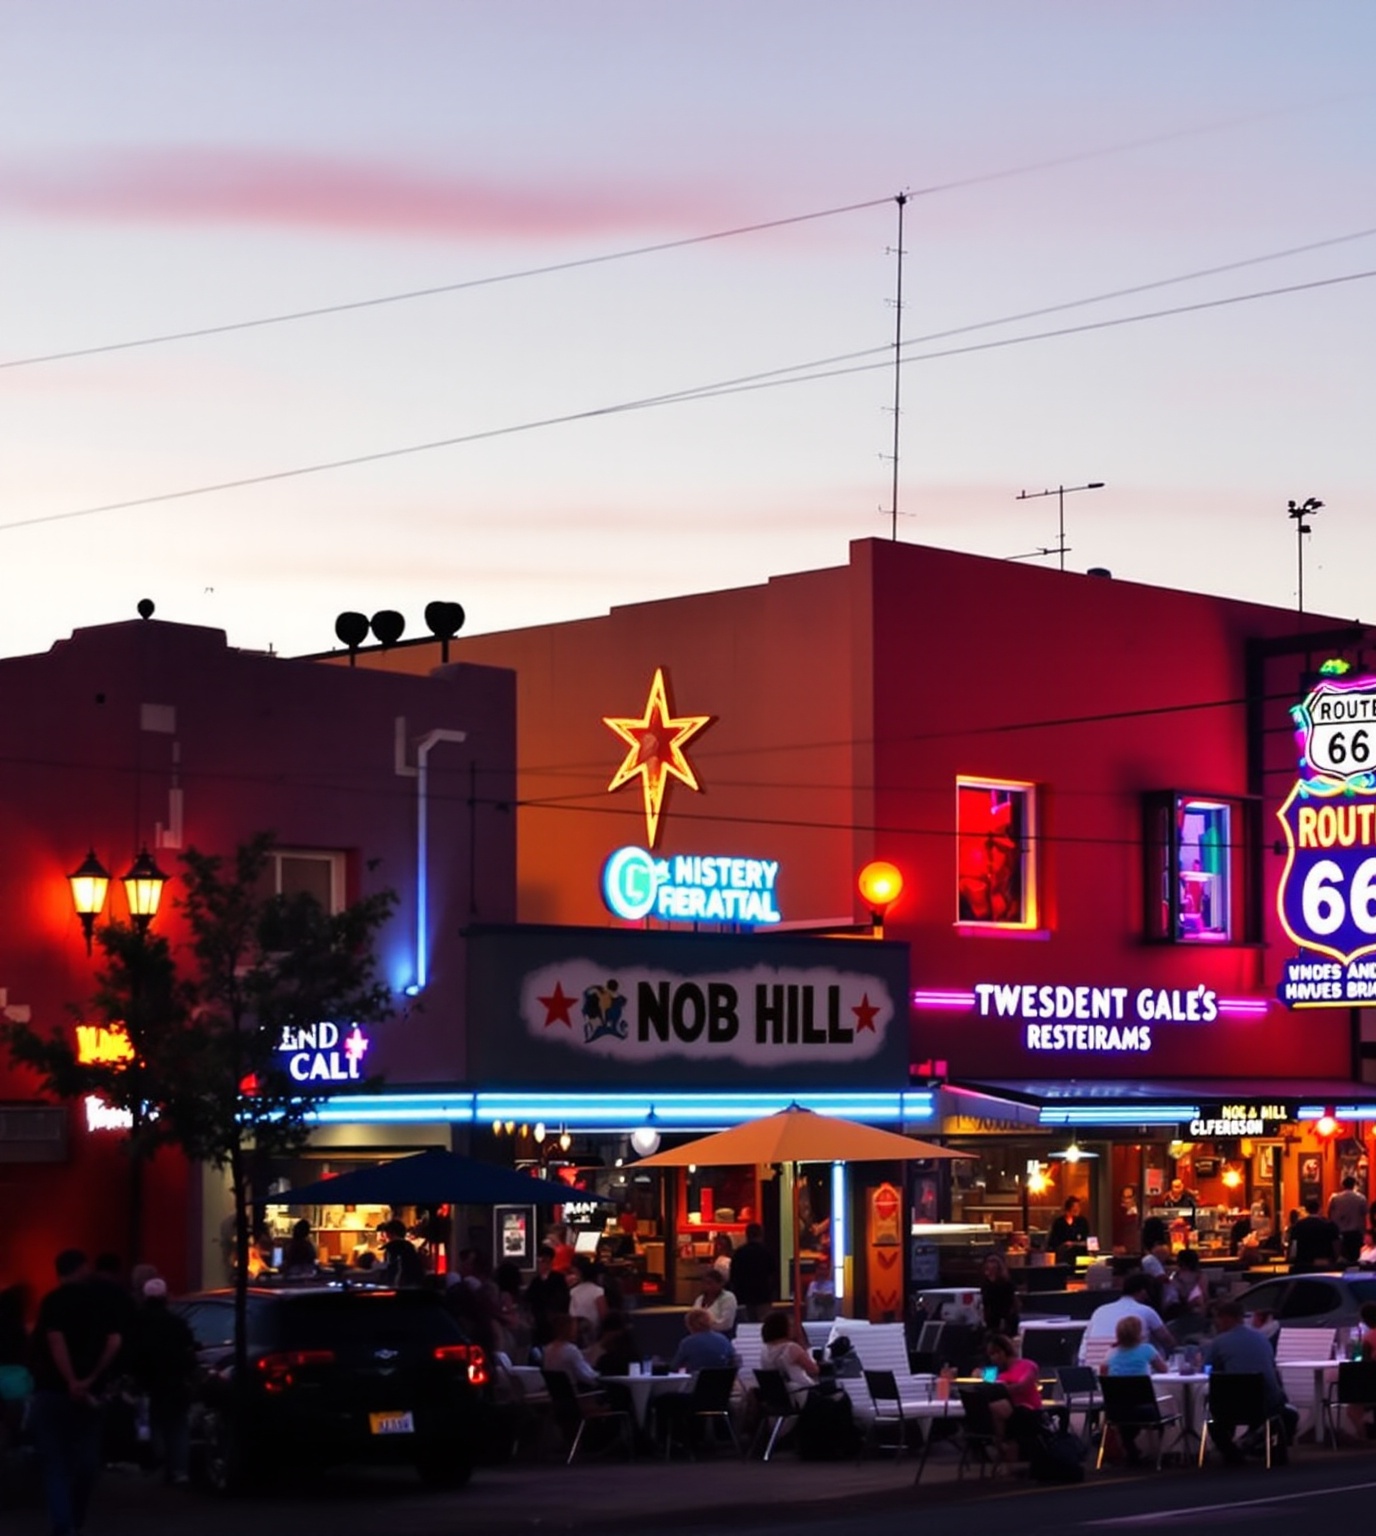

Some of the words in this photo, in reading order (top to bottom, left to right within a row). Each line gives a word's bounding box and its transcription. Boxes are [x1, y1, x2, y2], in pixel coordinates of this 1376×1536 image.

[1328, 729, 1370, 764] 66
[637, 981, 740, 1043] NOB
[755, 984, 854, 1044] HILL
[975, 984, 1128, 1019] TWESDENT
[1137, 984, 1218, 1021] GALE'S
